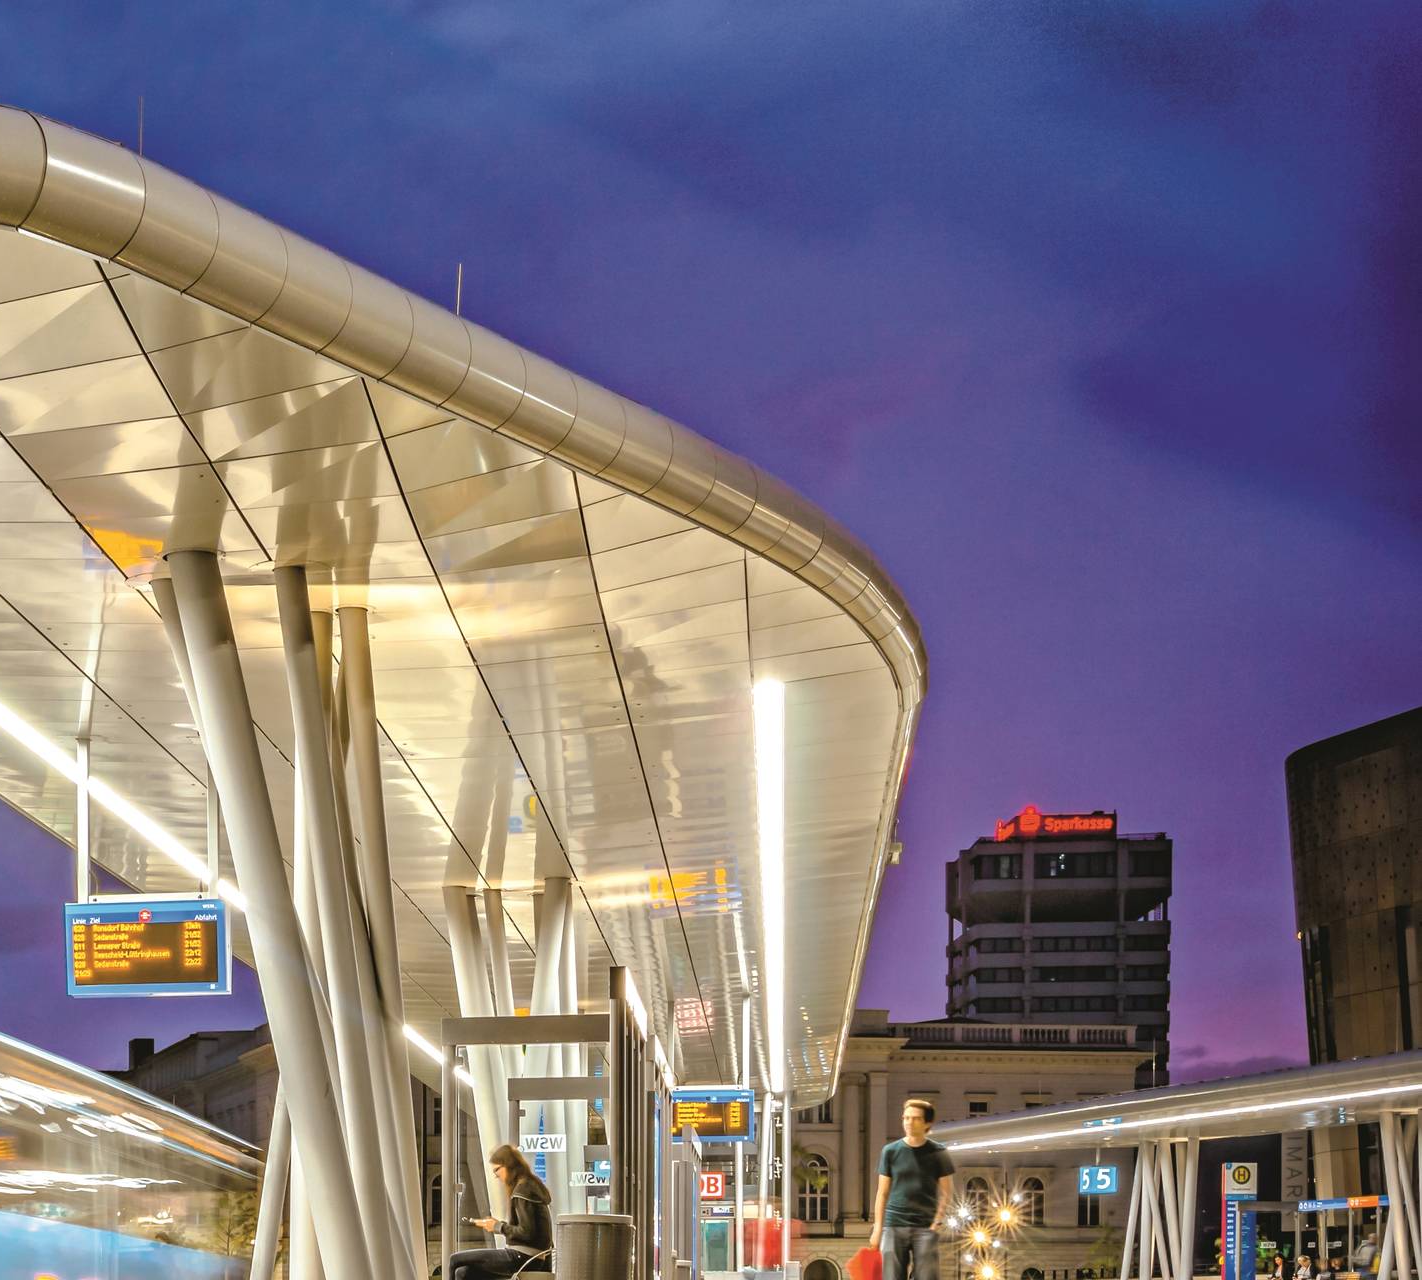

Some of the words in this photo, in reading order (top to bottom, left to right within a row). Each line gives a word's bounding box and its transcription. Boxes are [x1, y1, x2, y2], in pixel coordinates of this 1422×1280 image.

[1044, 816, 1113, 832] Sparkasse
[120, 923, 144, 931] Bahnhof
[701, 1177, 720, 1194] B
[1082, 1168, 1090, 1190] 5
[1096, 1168, 1111, 1190] 5
[1287, 1136, 1303, 1216] IMAR
